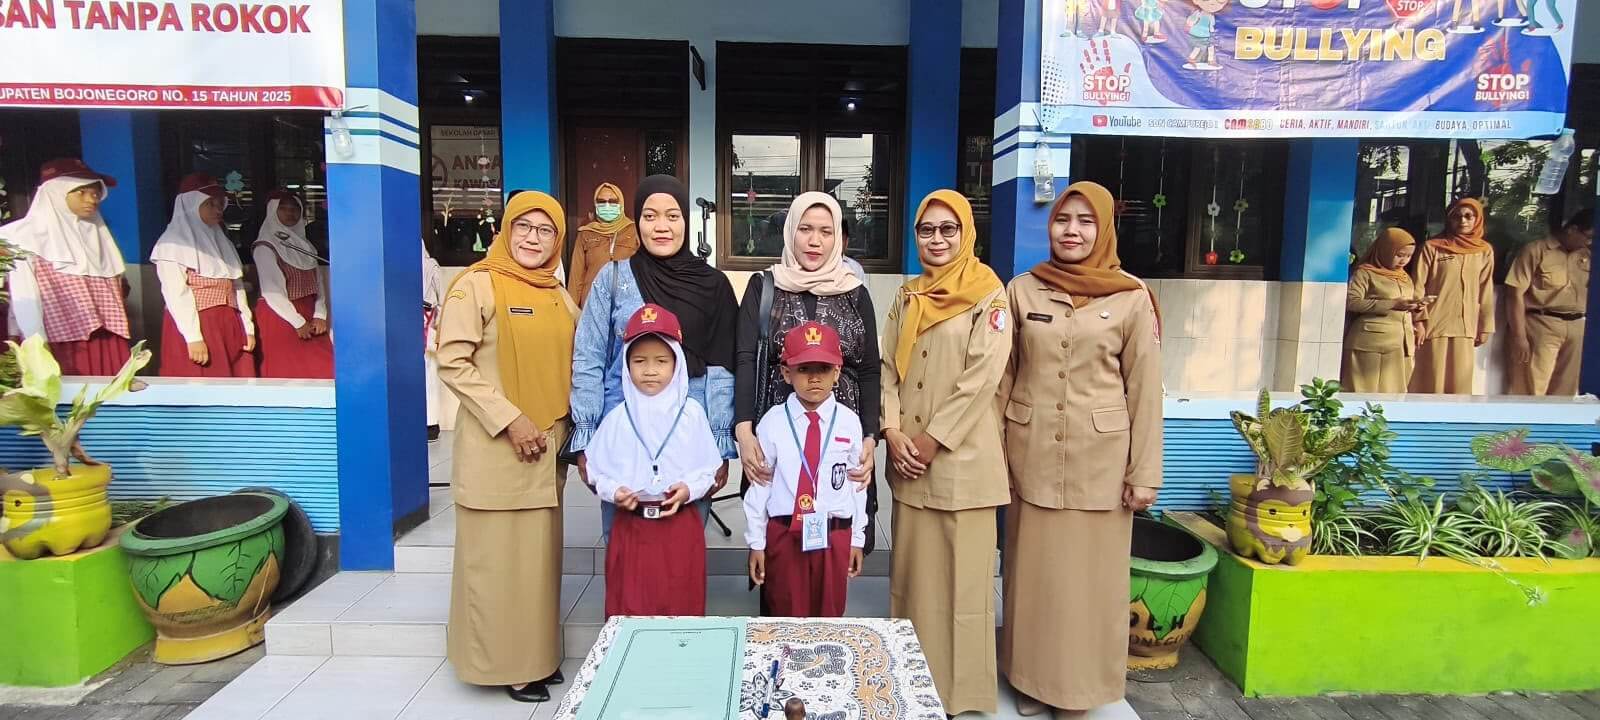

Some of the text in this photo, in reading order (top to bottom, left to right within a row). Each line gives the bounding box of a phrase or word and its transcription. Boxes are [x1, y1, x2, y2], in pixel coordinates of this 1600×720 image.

[0, 0, 311, 33] AN TANPA ROKOK
[1234, 27, 1446, 61] BULLYING
[1083, 74, 1130, 91] STOP
[1477, 73, 1529, 90] STOP
[54, 88, 157, 101] BOJONEGORO
[162, 90, 188, 101] NO.
[192, 91, 207, 101] 15
[211, 91, 258, 102] TAHUN
[262, 91, 291, 102] 2025
[1083, 91, 1130, 101] BULLYING!
[1475, 91, 1529, 101] BULLYING!
[1109, 115, 1141, 127] YouTube
[1279, 119, 1306, 129] CERIA,
[1308, 119, 1334, 130] AKTIF,
[1337, 119, 1372, 131] MANDIRI,
[1472, 120, 1512, 130] OPTIMAL
